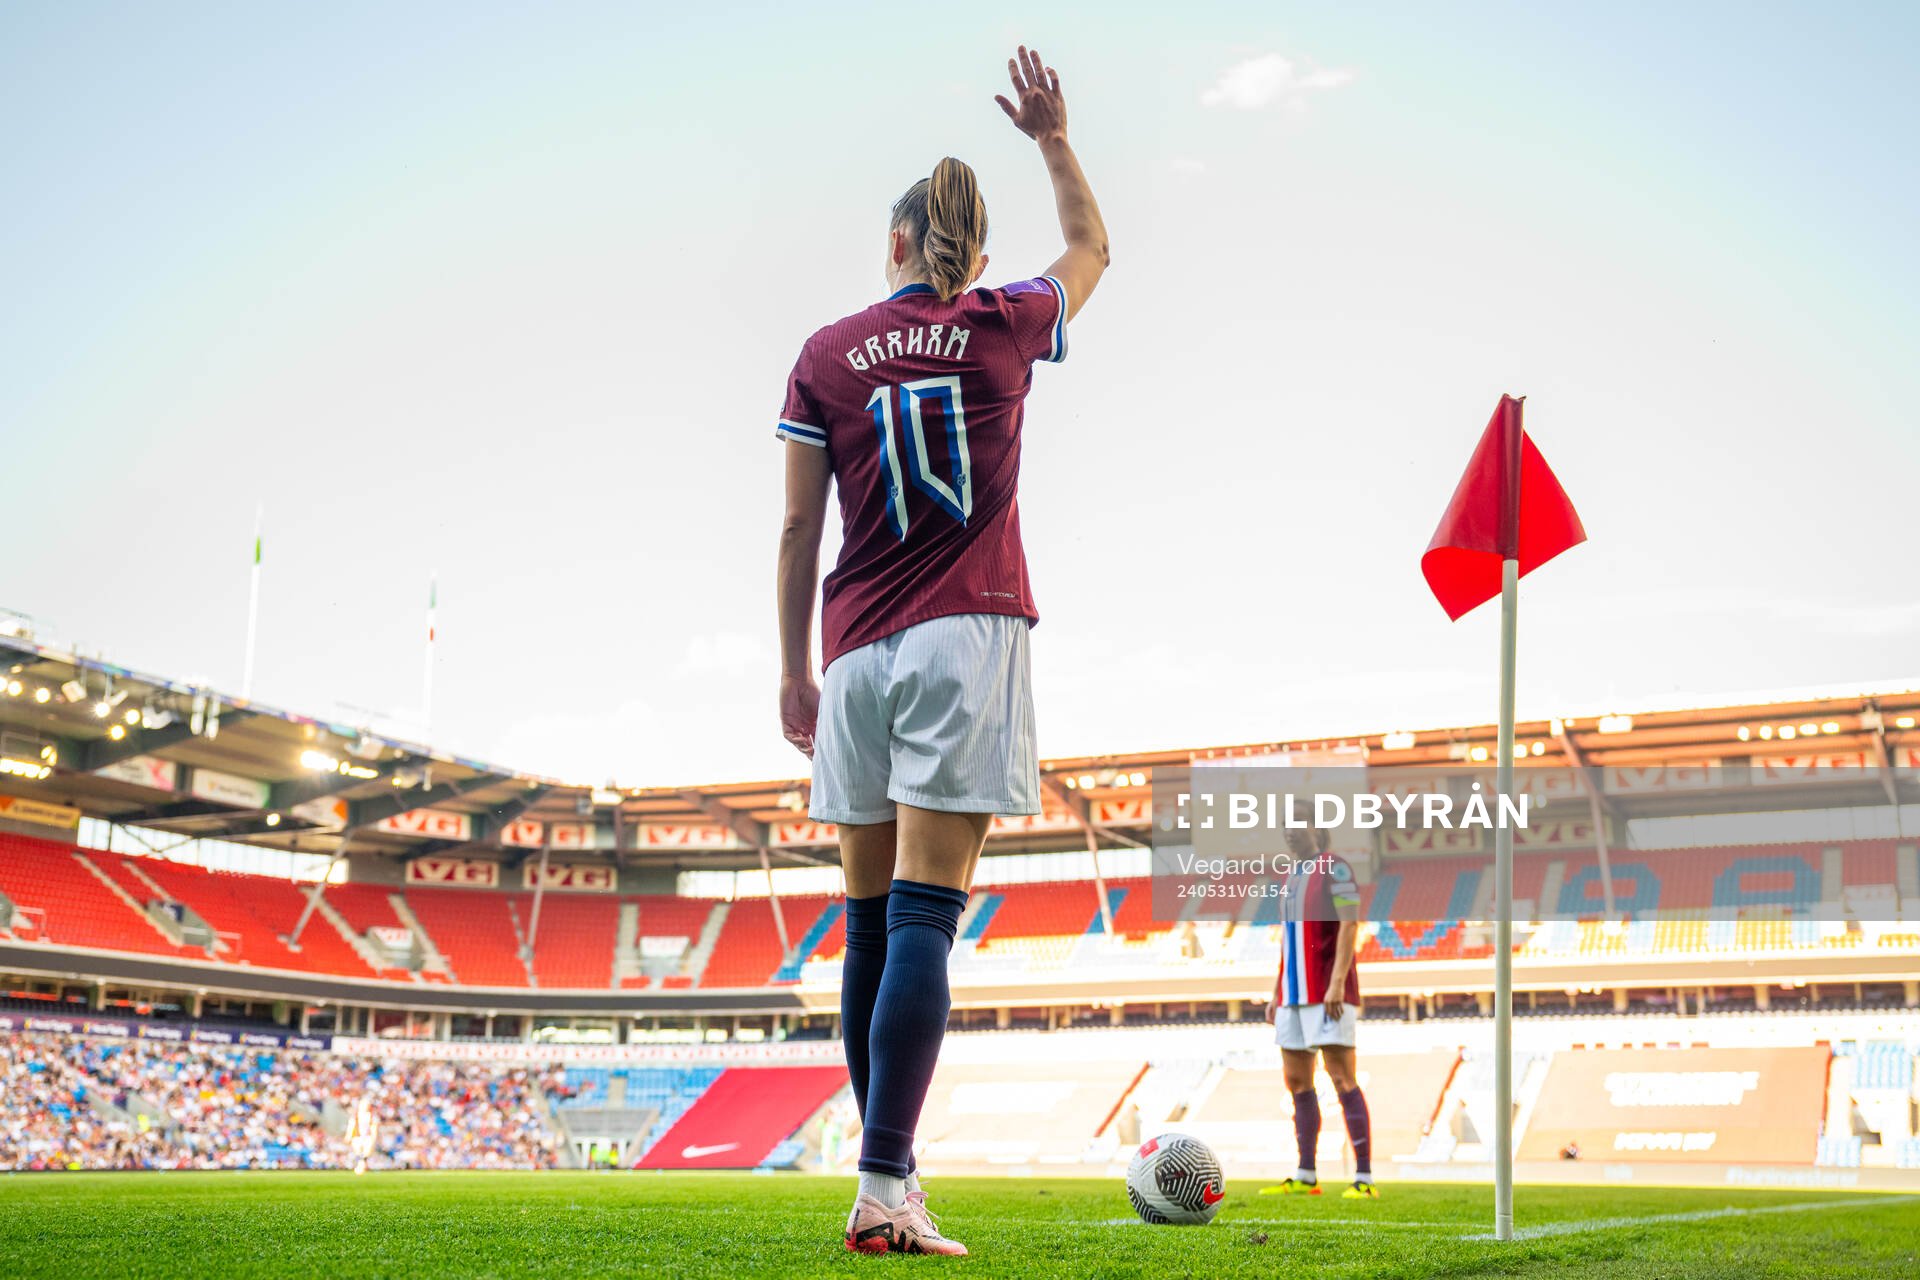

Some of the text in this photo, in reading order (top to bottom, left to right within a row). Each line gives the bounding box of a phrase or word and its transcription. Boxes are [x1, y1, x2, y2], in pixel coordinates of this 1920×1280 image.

[846, 324, 970, 371] GRAHAM
[865, 375, 973, 542] 10
[390, 809, 458, 839] VG
[649, 825, 724, 846] VG
[413, 860, 492, 885] VG
[530, 865, 610, 890] VG
